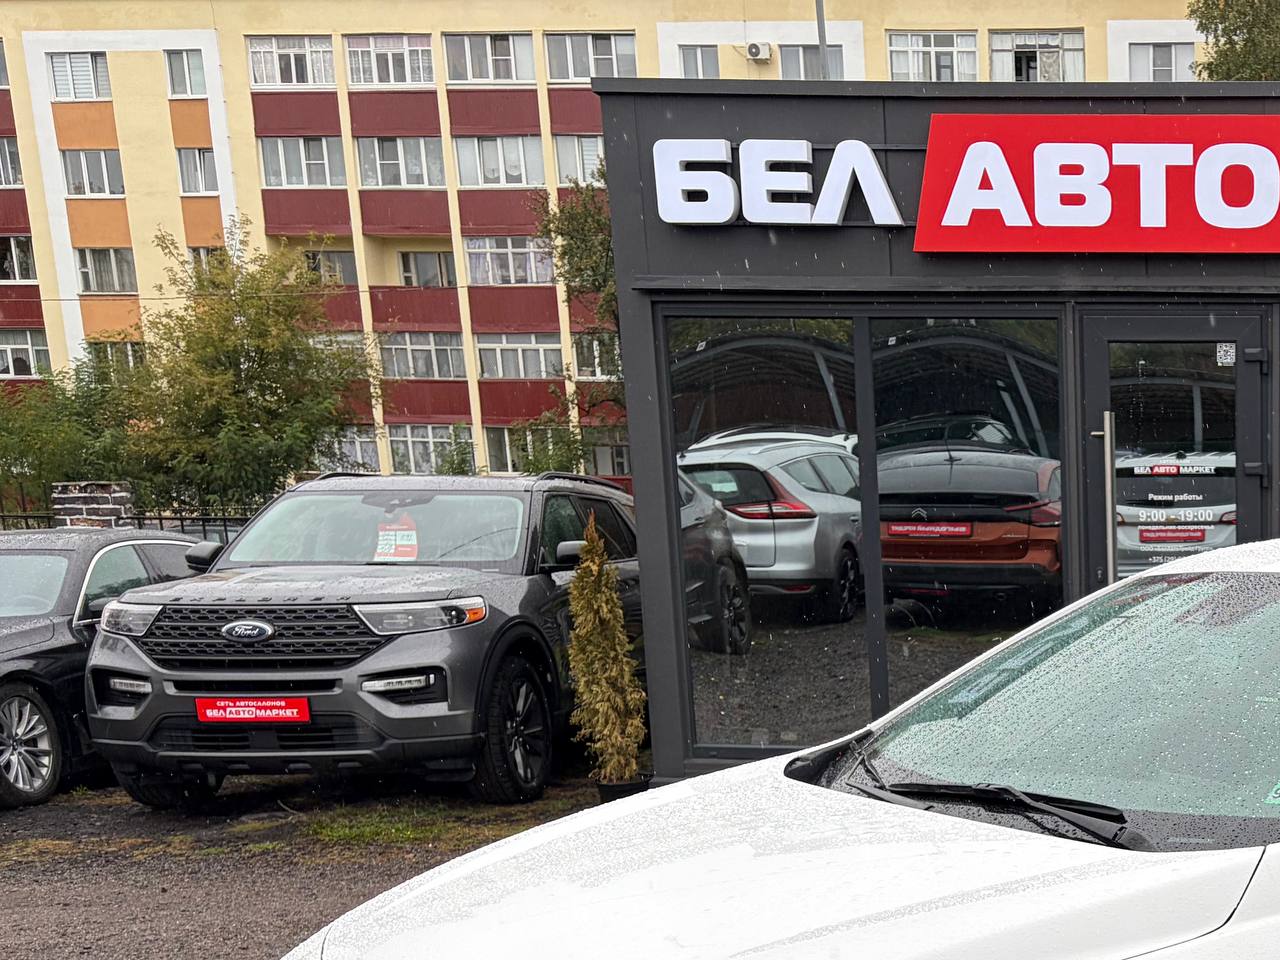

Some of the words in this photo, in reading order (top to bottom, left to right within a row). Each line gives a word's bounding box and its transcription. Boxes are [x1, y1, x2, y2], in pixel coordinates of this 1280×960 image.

[652, 138, 905, 226] БЕЛ
[1153, 466, 1177, 474] АВТО
[1148, 493, 1173, 501] Режим
[1174, 493, 1203, 502] работы
[1138, 510, 1166, 522] 9:00
[1179, 510, 1213, 521] 19:00
[232, 625, 260, 637] Ford
[206, 709, 226, 718] БЕЛ
[228, 709, 254, 717] АВТО
[256, 708, 300, 718] МАРКЕТ
